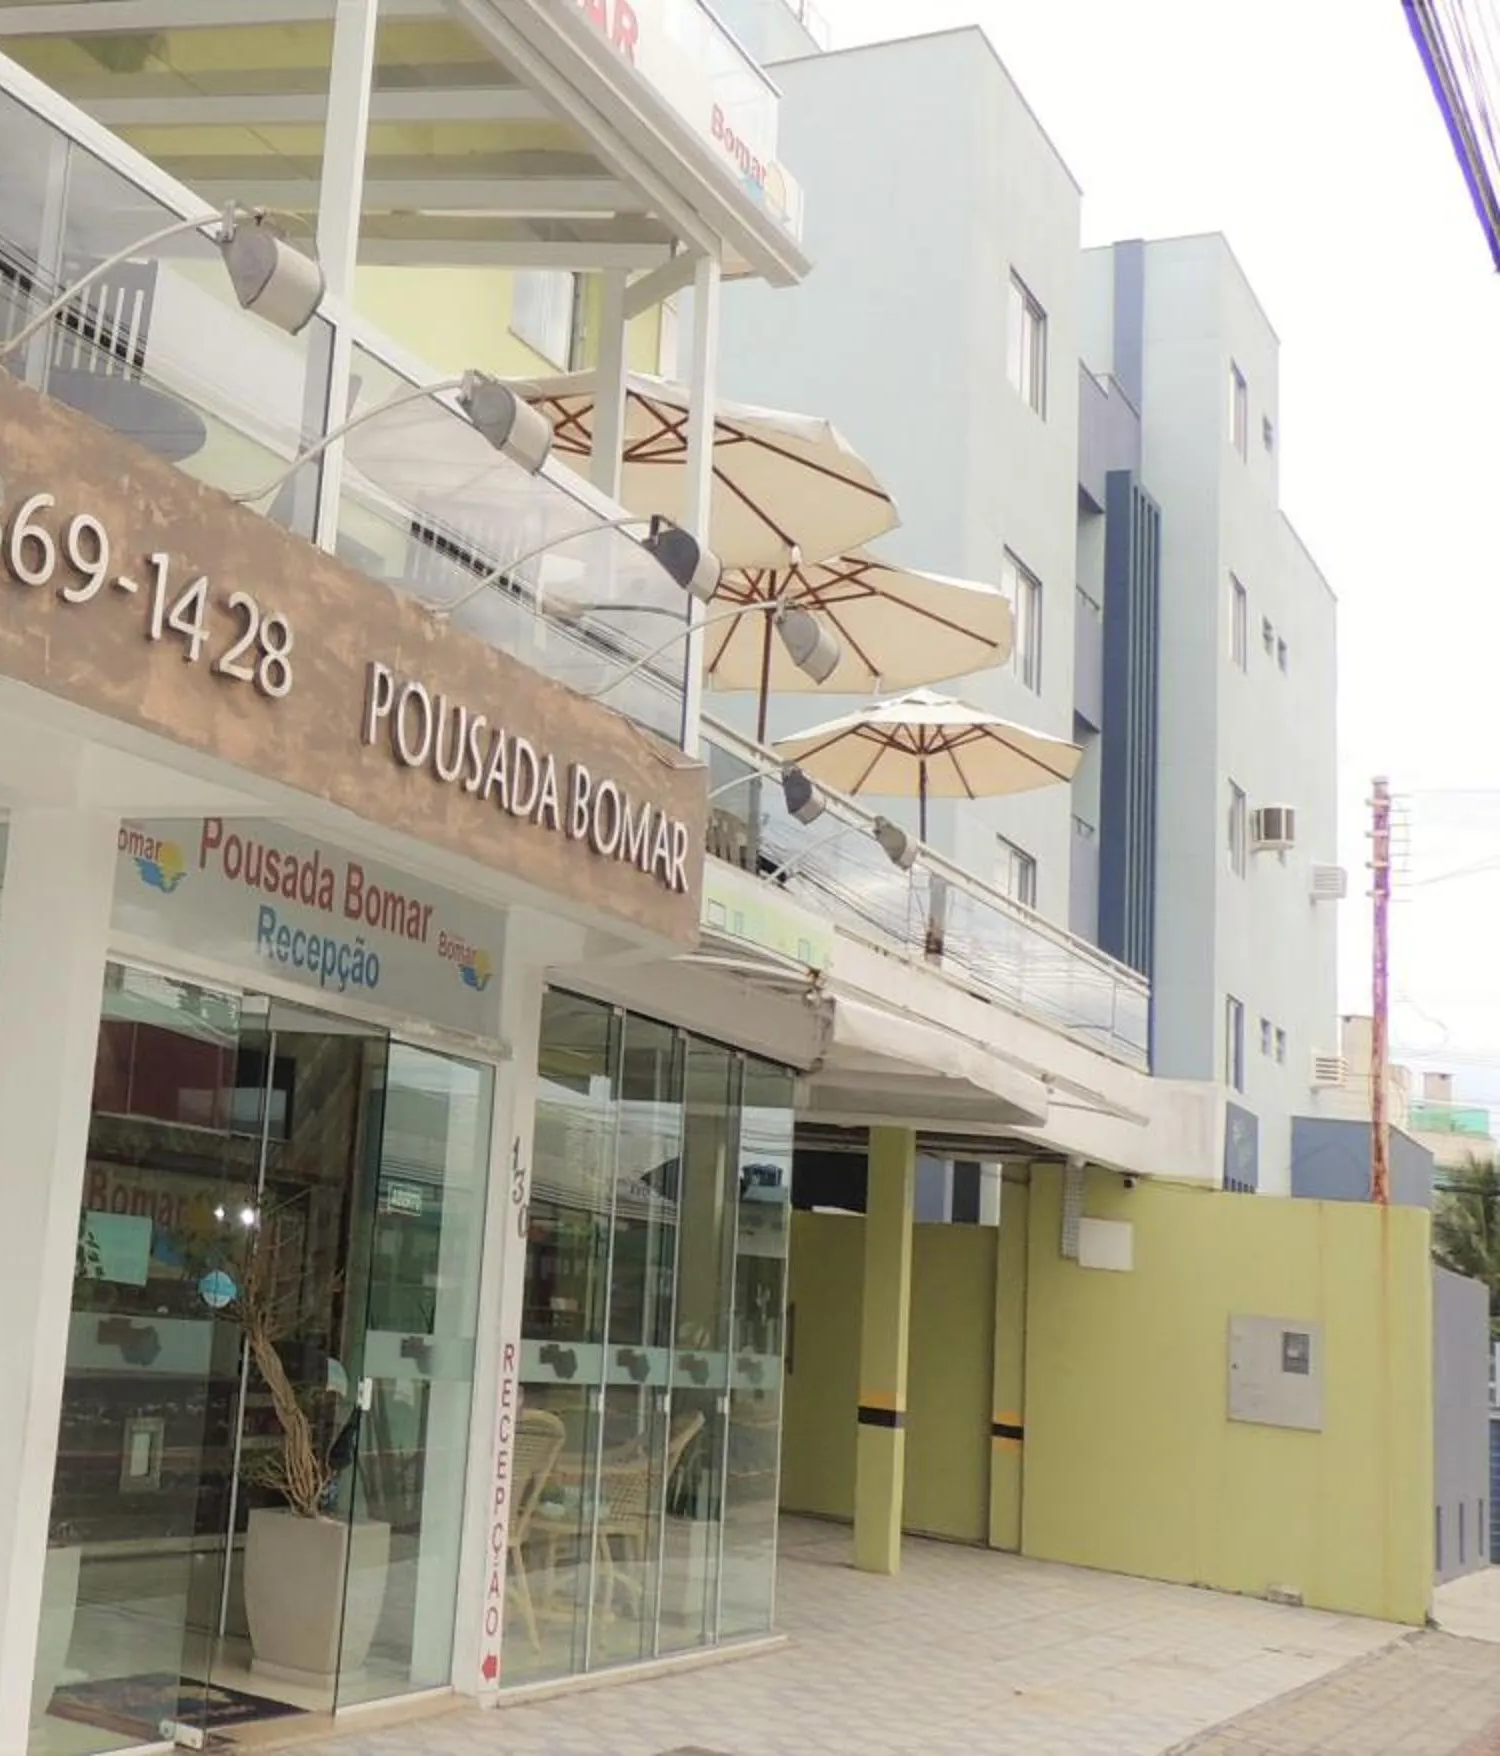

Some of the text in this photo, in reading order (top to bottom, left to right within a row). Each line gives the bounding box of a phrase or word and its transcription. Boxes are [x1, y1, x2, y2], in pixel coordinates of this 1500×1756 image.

[711, 102, 767, 184] Bomar
[362, 661, 689, 893] POUSADA BOMAR
[118, 827, 163, 861] omar
[200, 817, 433, 943] Pousada Bomar
[256, 904, 380, 993] Recepção
[437, 931, 479, 965] Bomar
